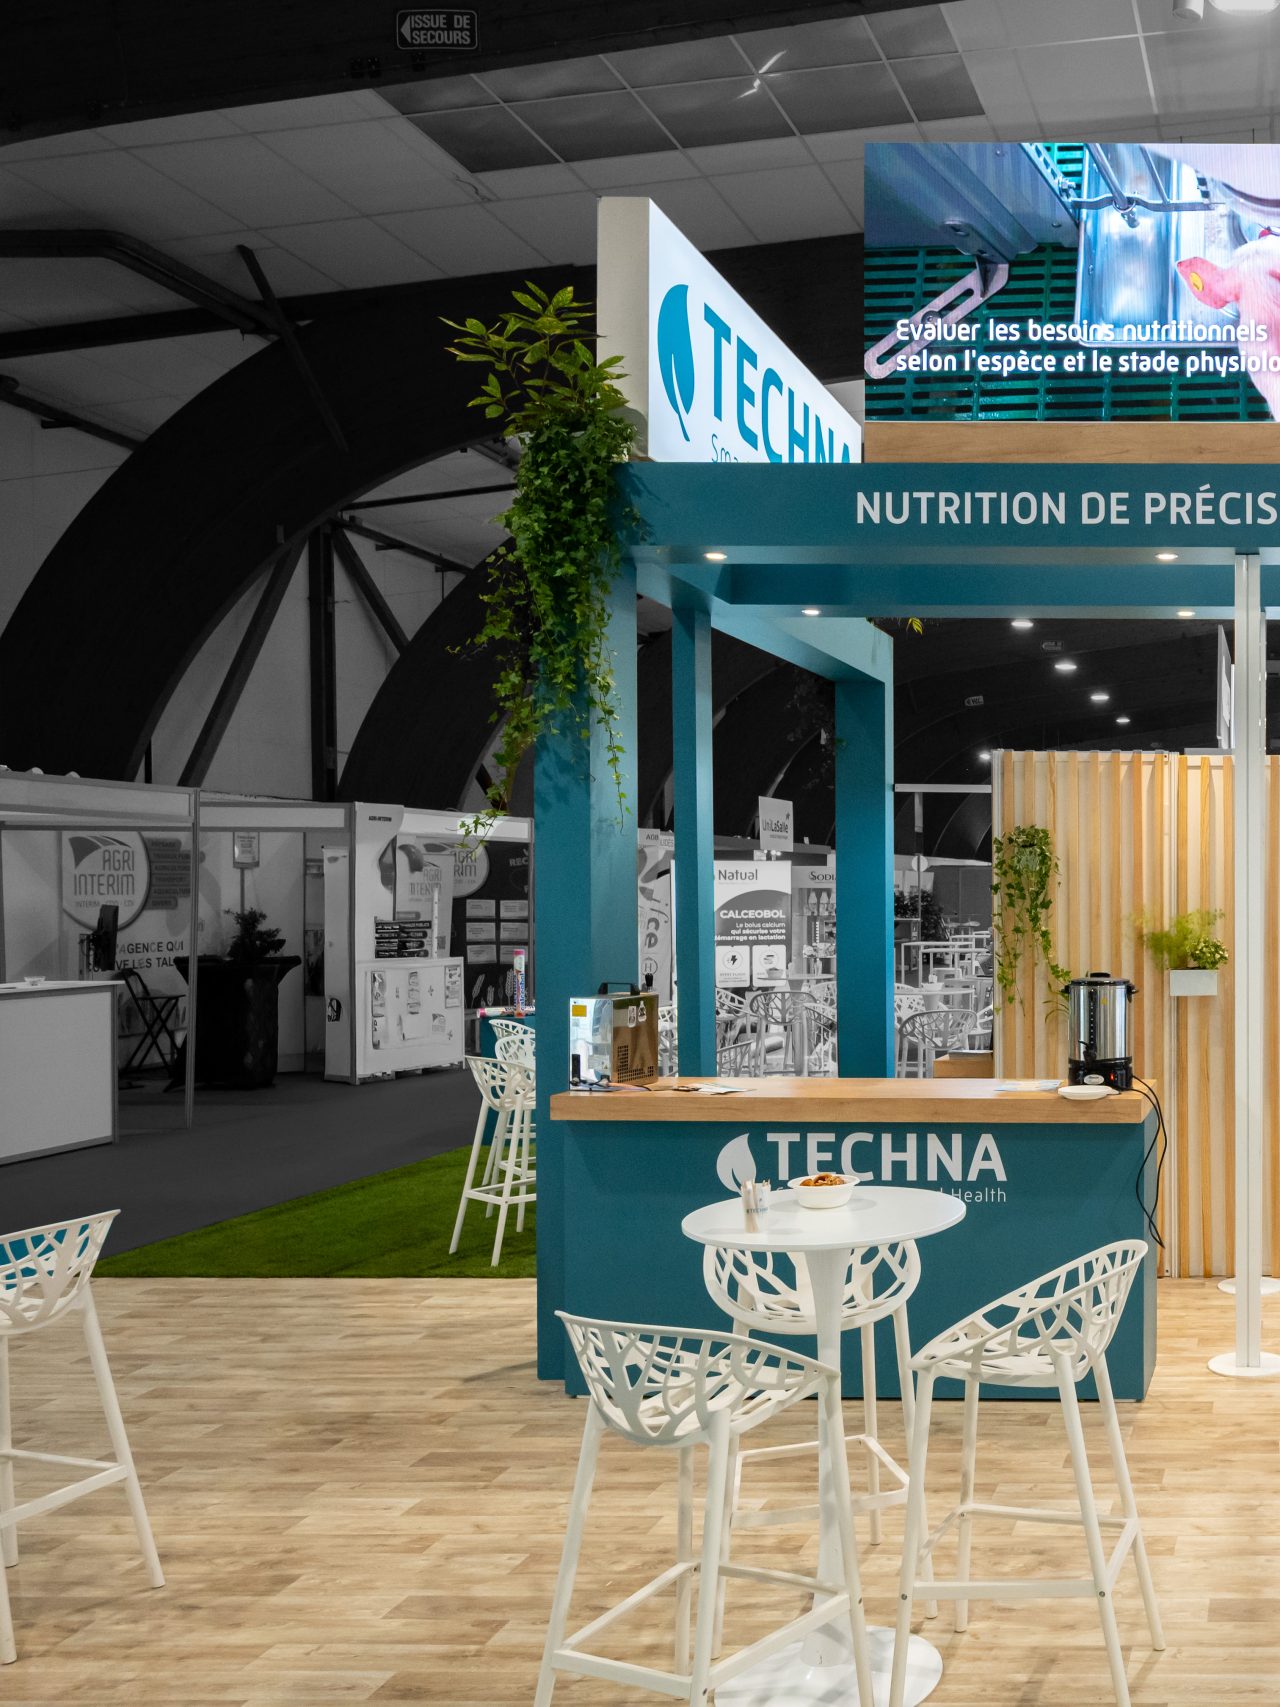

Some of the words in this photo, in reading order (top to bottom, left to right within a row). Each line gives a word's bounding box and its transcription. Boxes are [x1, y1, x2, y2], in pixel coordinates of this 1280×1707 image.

[411, 14, 447, 29] ISSUE
[453, 14, 471, 29] DE
[412, 30, 471, 45] SECOURS
[988, 319, 1020, 342] les
[1028, 319, 1115, 342] besoins
[1122, 319, 1268, 342] nutritionnels
[896, 350, 957, 373] selon
[964, 350, 1056, 377] l'espèce
[1063, 350, 1086, 373] et
[1092, 350, 1113, 373] le
[1119, 350, 1179, 373] stade
[703, 301, 850, 464] TECHN
[856, 491, 1066, 525] NUTRITION
[1081, 491, 1130, 525] DE
[762, 818, 789, 834] UniLaSalle
[102, 849, 135, 872] AGRI
[718, 868, 759, 881] Natual
[73, 873, 135, 896] INTERIM
[720, 909, 786, 919] CALCEOBOL
[742, 927, 768, 935] sécurise
[166, 940, 184, 952] QUI
[132, 958, 152, 969] LES
[766, 1131, 1008, 1182] TECHNA
[951, 1186, 1007, 1203] Health
